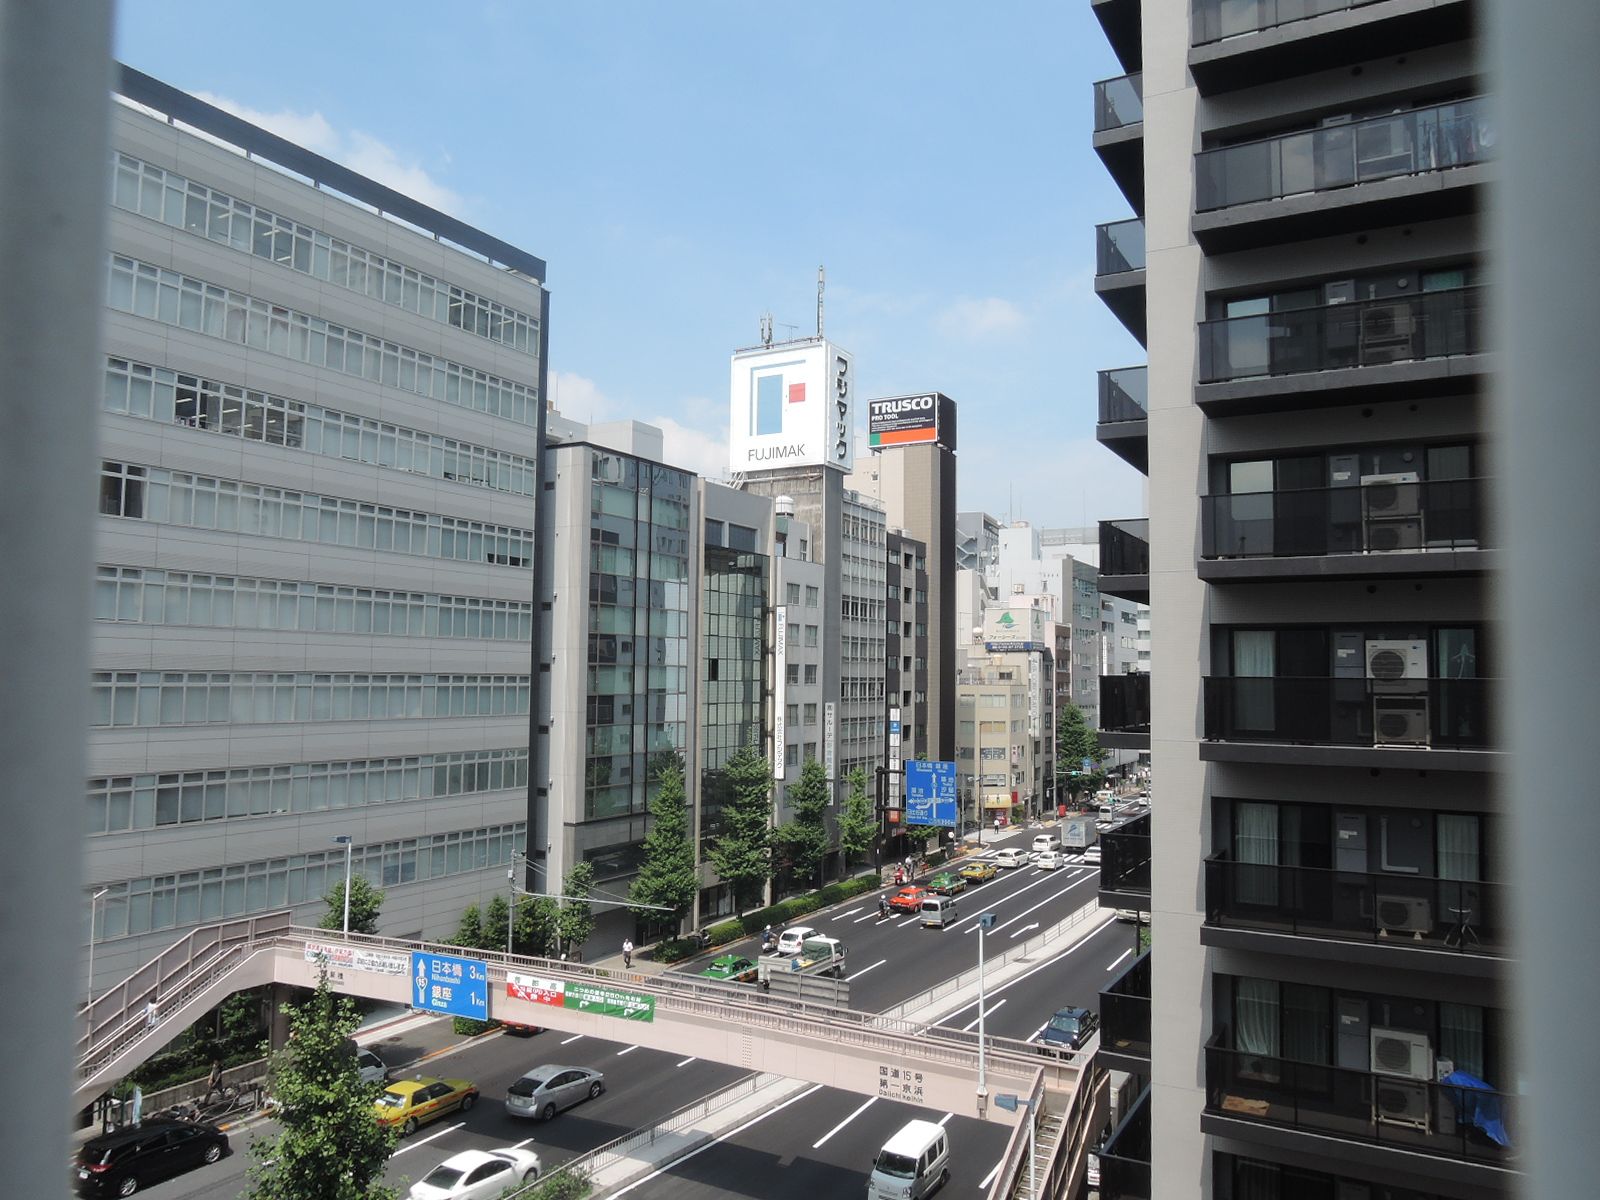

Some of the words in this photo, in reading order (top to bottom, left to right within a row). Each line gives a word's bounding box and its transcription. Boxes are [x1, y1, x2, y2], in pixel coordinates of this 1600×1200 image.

[835, 355, 848, 459] フジマック
[871, 397, 933, 414] TRUSCO
[748, 443, 805, 462] FUJIMAK
[432, 959, 462, 977] 日本橋
[432, 985, 452, 1001] 銀座
[432, 998, 448, 1008] Ginza
[880, 1066, 923, 1083] 国道15号
[880, 1079, 924, 1096] 第一京浜
